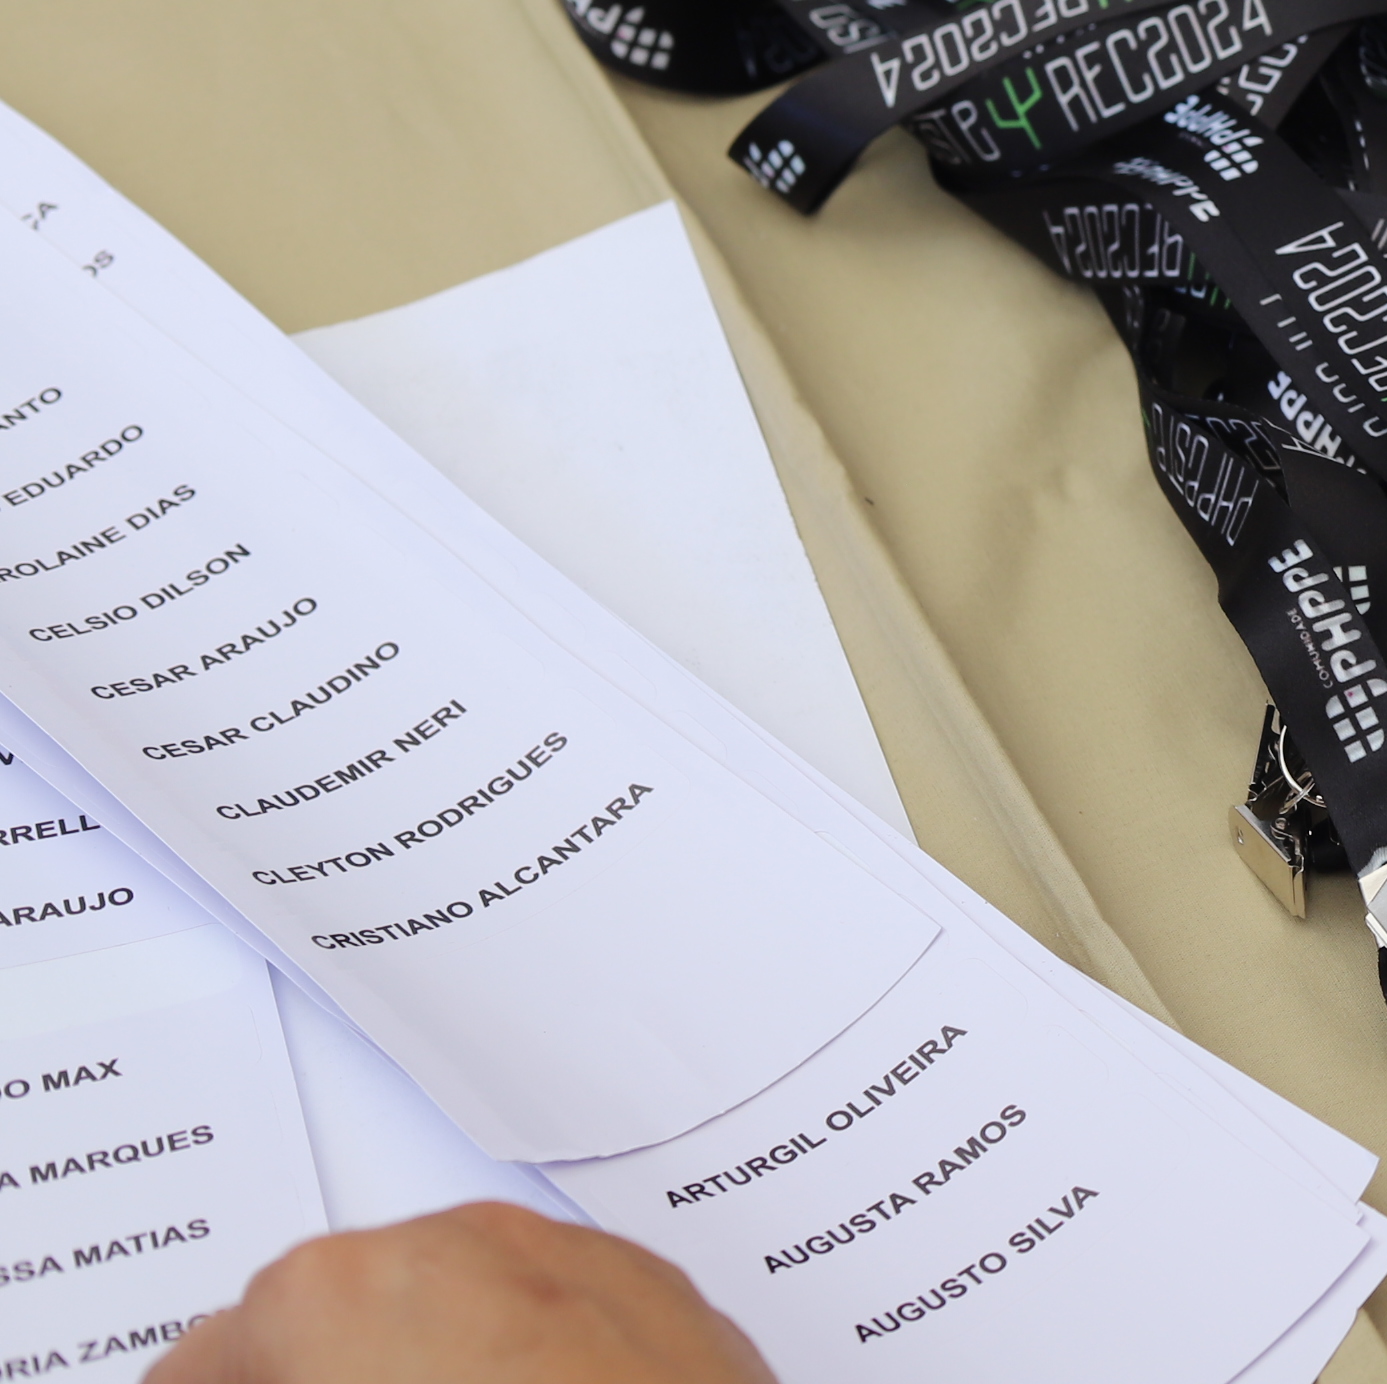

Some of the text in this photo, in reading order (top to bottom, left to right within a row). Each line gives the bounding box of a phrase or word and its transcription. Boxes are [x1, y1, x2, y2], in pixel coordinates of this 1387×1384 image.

[3, 424, 144, 507] EDUARDO
[126, 483, 197, 531] DIAS
[28, 543, 251, 642] CELSIO DILSON
[1267, 537, 1376, 684] PHPPE
[1286, 606, 1334, 689] COMUNIDADE
[90, 597, 318, 700] CESAR ARAUJO
[142, 641, 403, 761] CESAR CLAUDINO
[216, 699, 470, 822] CLAUDEMIR NERI
[251, 729, 570, 890] CLEYTON RODRIGUES
[311, 779, 656, 955] CRISTIANO ALCANTARA
[41, 1058, 123, 1093] MAX
[665, 1024, 969, 1210] ARTURGIL OLIVEIRA
[29, 1124, 215, 1186] MARQUES
[762, 1103, 1030, 1276] AUGUSTA RAMOS
[72, 1218, 211, 1269] MATIAS
[852, 1183, 1100, 1345] AUGUSTO SILVA
